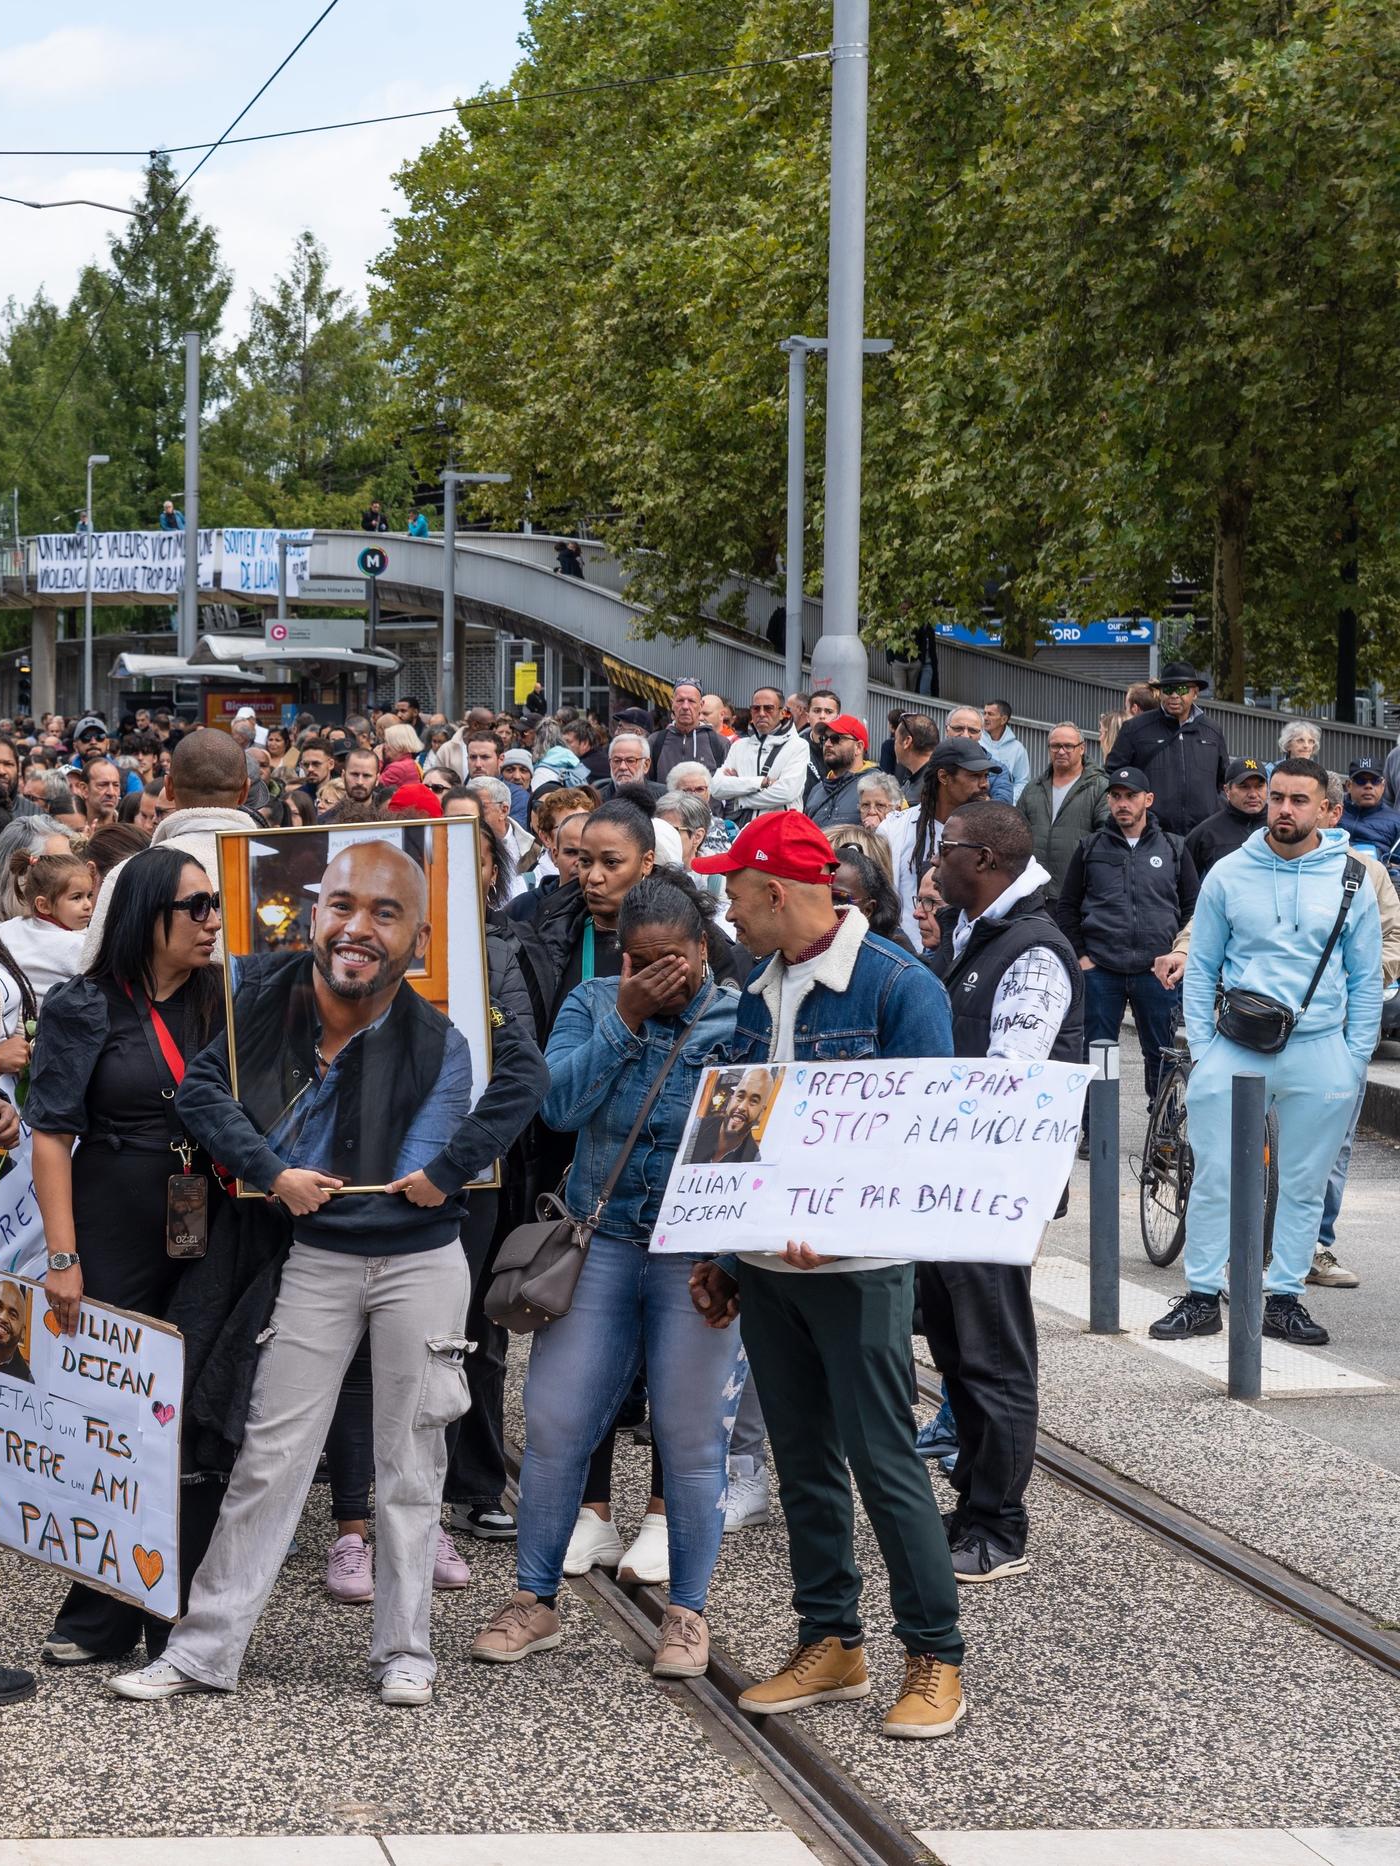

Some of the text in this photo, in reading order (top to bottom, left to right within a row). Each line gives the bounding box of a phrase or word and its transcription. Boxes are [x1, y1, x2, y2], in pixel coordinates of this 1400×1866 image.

[36, 535, 52, 561] UN
[90, 534, 104, 561] DE
[106, 534, 149, 561] VALEURS
[223, 529, 256, 558] SOUTIEN
[240, 559, 251, 591] DE
[365, 553, 380, 569] M
[93, 565, 140, 590] DEVENUE
[141, 565, 164, 590] TROP
[1047, 627, 1081, 641] ORD
[1115, 635, 1130, 643] SUD
[807, 1071, 915, 1101] REPOSE
[802, 1109, 891, 1146] STOP
[929, 1115, 960, 1143] LA
[665, 1201, 749, 1227] DEJEAN
[786, 1176, 1030, 1222] TUÉ PAR BALLES
[78, 1313, 144, 1355] ILIAN
[60, 1344, 157, 1400] DEJEAN
[70, 1479, 86, 1492] UN
[89, 1467, 140, 1516] AMI
[16, 1500, 122, 1584] PAPA
